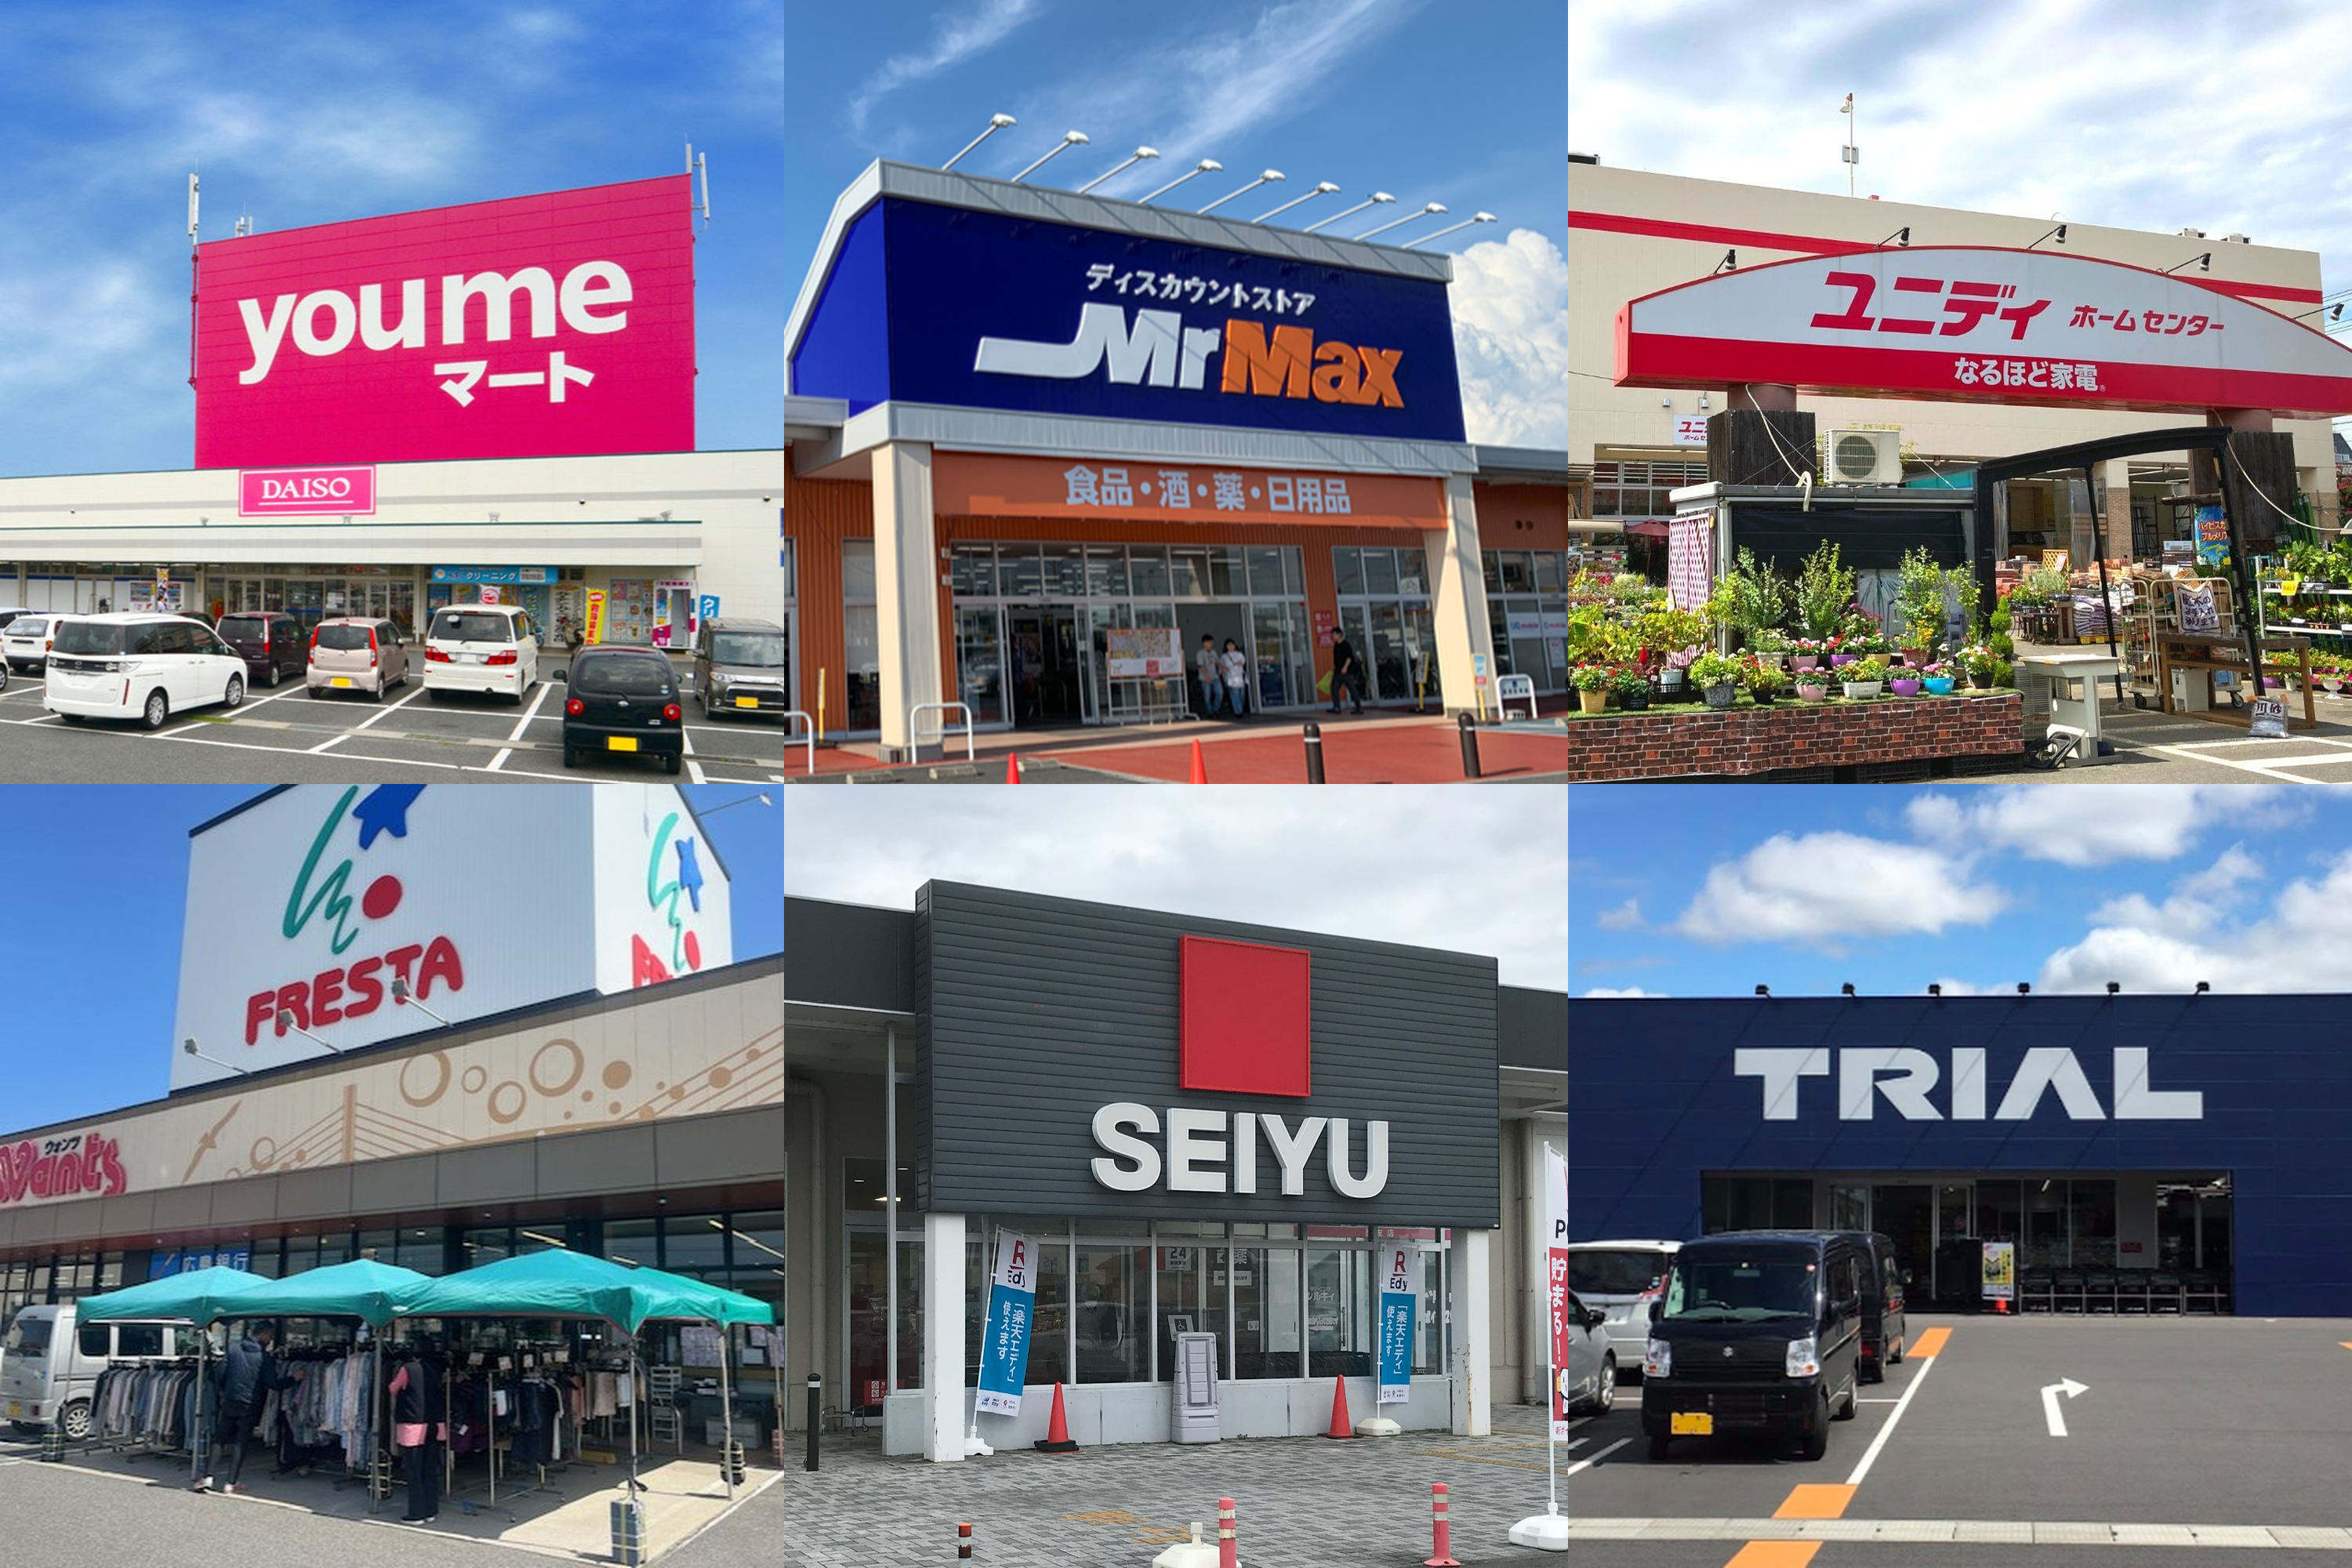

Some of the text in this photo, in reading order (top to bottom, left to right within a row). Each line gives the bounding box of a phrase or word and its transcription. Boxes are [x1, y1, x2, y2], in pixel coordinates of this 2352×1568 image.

[1086, 263, 1316, 315] ディスカウントストア
[1810, 270, 2051, 341] ユニディ
[238, 260, 633, 385] youme
[434, 351, 595, 408] マート
[1678, 421, 1708, 433] ユニ
[261, 477, 350, 499] DAISO
[1064, 465, 1351, 514] 食品・酒・薬・日用品
[245, 936, 463, 1046] FRESTA
[1734, 1047, 2203, 1120] TRIAL
[1091, 1102, 1389, 1200] SEIYU
[1555, 1219, 1568, 1239] P
[1007, 1269, 1025, 1288] Edy
[1390, 1277, 1408, 1291] Edy
[1395, 1250, 1406, 1273] R
[997, 1301, 1011, 1360] 使えます
[1007, 1302, 1025, 1383] 「楽天エディ」
[1386, 1305, 1395, 1357] 使えます
[1393, 1305, 1408, 1374] 「楽天エディ」
